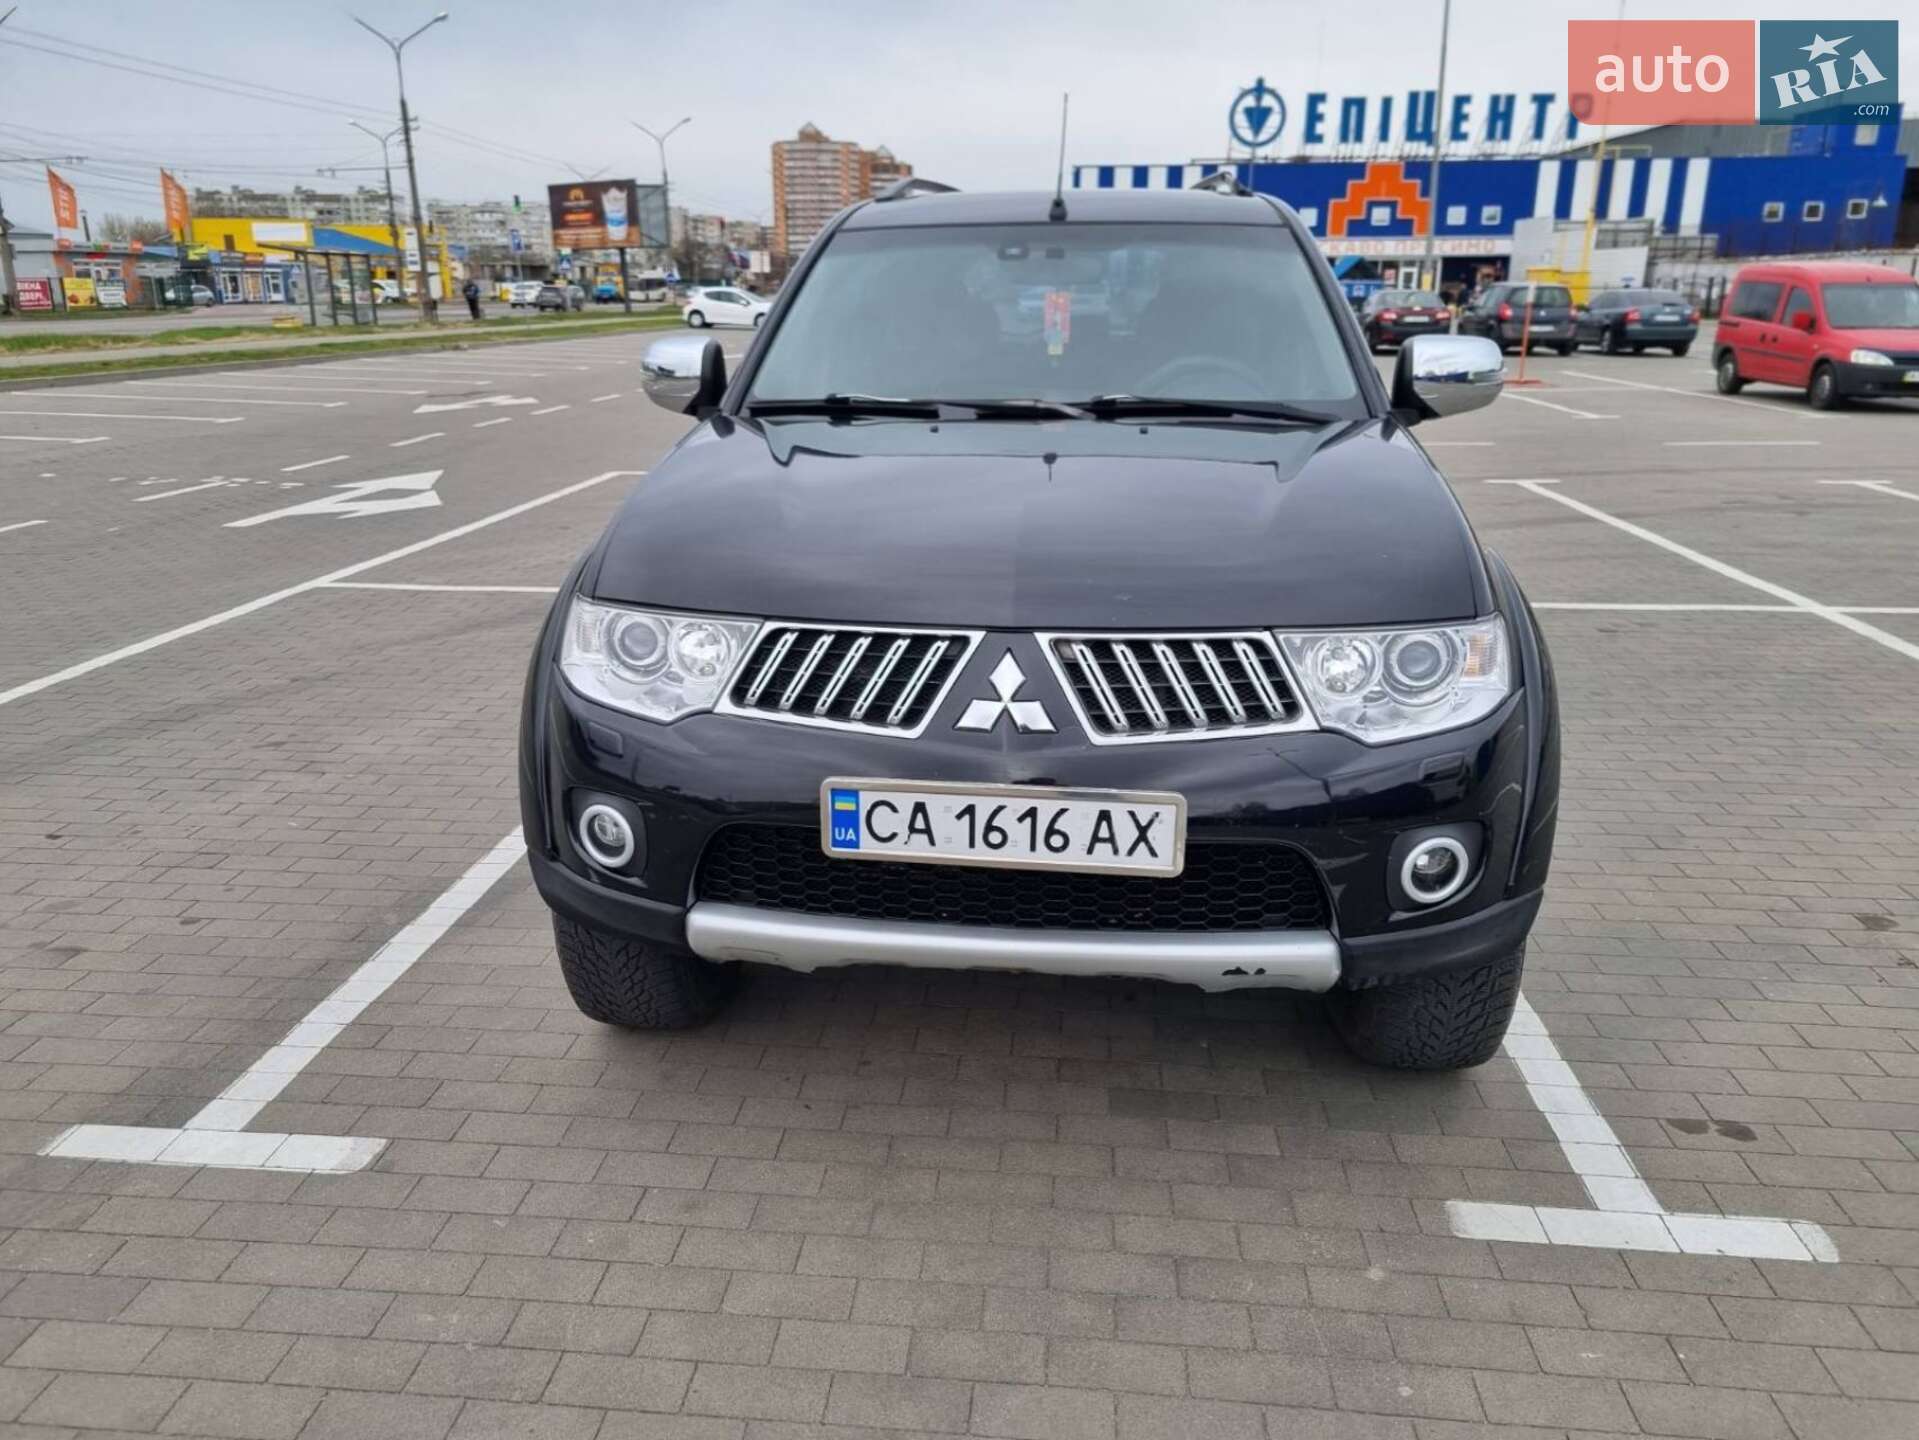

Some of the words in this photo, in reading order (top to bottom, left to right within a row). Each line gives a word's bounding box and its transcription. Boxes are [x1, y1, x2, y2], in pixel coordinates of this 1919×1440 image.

[1394, 239, 1497, 253] ПРСИМО
[834, 826, 857, 842] UA
[865, 800, 936, 847] CA
[954, 804, 1071, 853] 1616
[1086, 809, 1161, 858] AX
